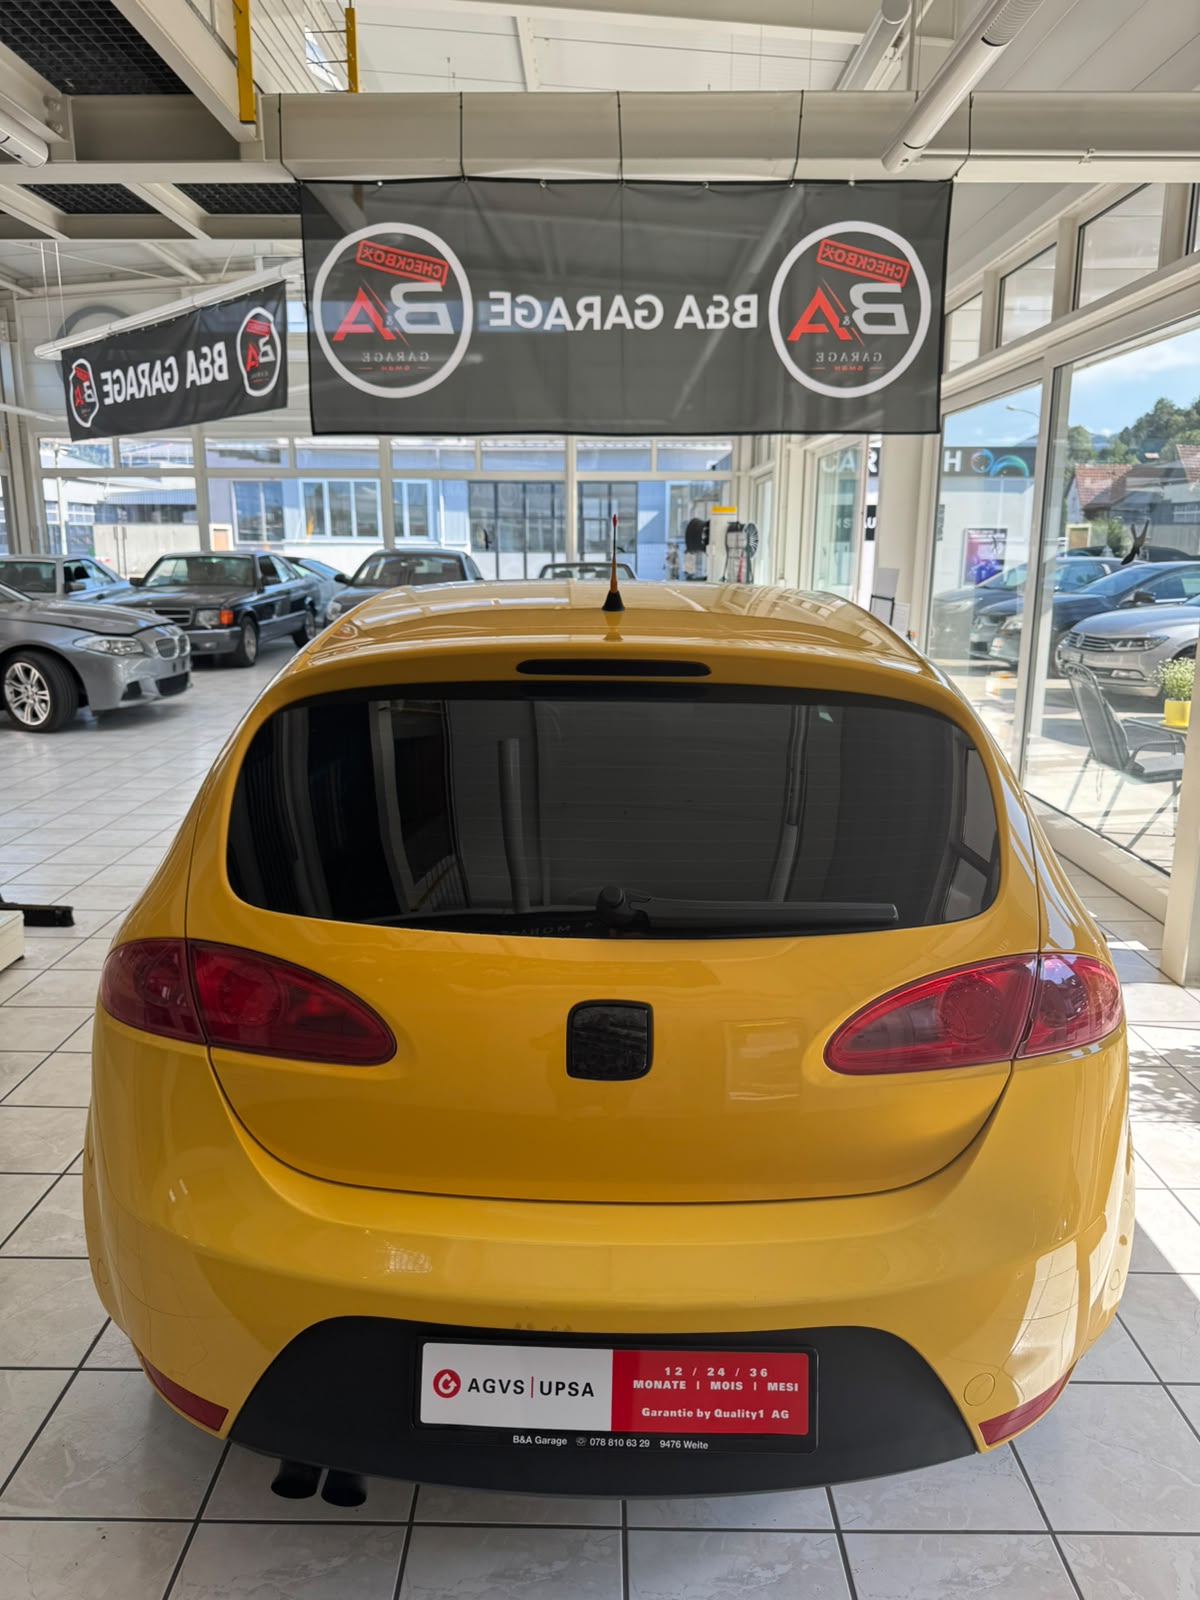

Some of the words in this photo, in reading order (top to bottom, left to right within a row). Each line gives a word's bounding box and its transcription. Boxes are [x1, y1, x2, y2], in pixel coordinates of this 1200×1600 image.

[664, 1367, 683, 1376] 12
[707, 1367, 725, 1376] 24
[749, 1368, 768, 1377] 36
[467, 1378, 525, 1395] AGVS
[539, 1381, 595, 1397] UPSA
[633, 1380, 686, 1389] MONATE
[710, 1381, 743, 1391] MOIS
[767, 1382, 799, 1391] MESI
[641, 1407, 693, 1418] Garantie
[696, 1409, 711, 1420] by
[714, 1409, 764, 1420] Quality1
[771, 1410, 790, 1419] AG
[513, 1435, 533, 1444] B&A
[535, 1436, 568, 1446] Garage
[590, 1438, 606, 1446] 078
[608, 1439, 624, 1447] 810
[626, 1439, 637, 1447] 63
[639, 1439, 650, 1447] 29
[659, 1440, 681, 1448] 9476
[683, 1440, 709, 1449] Weite
